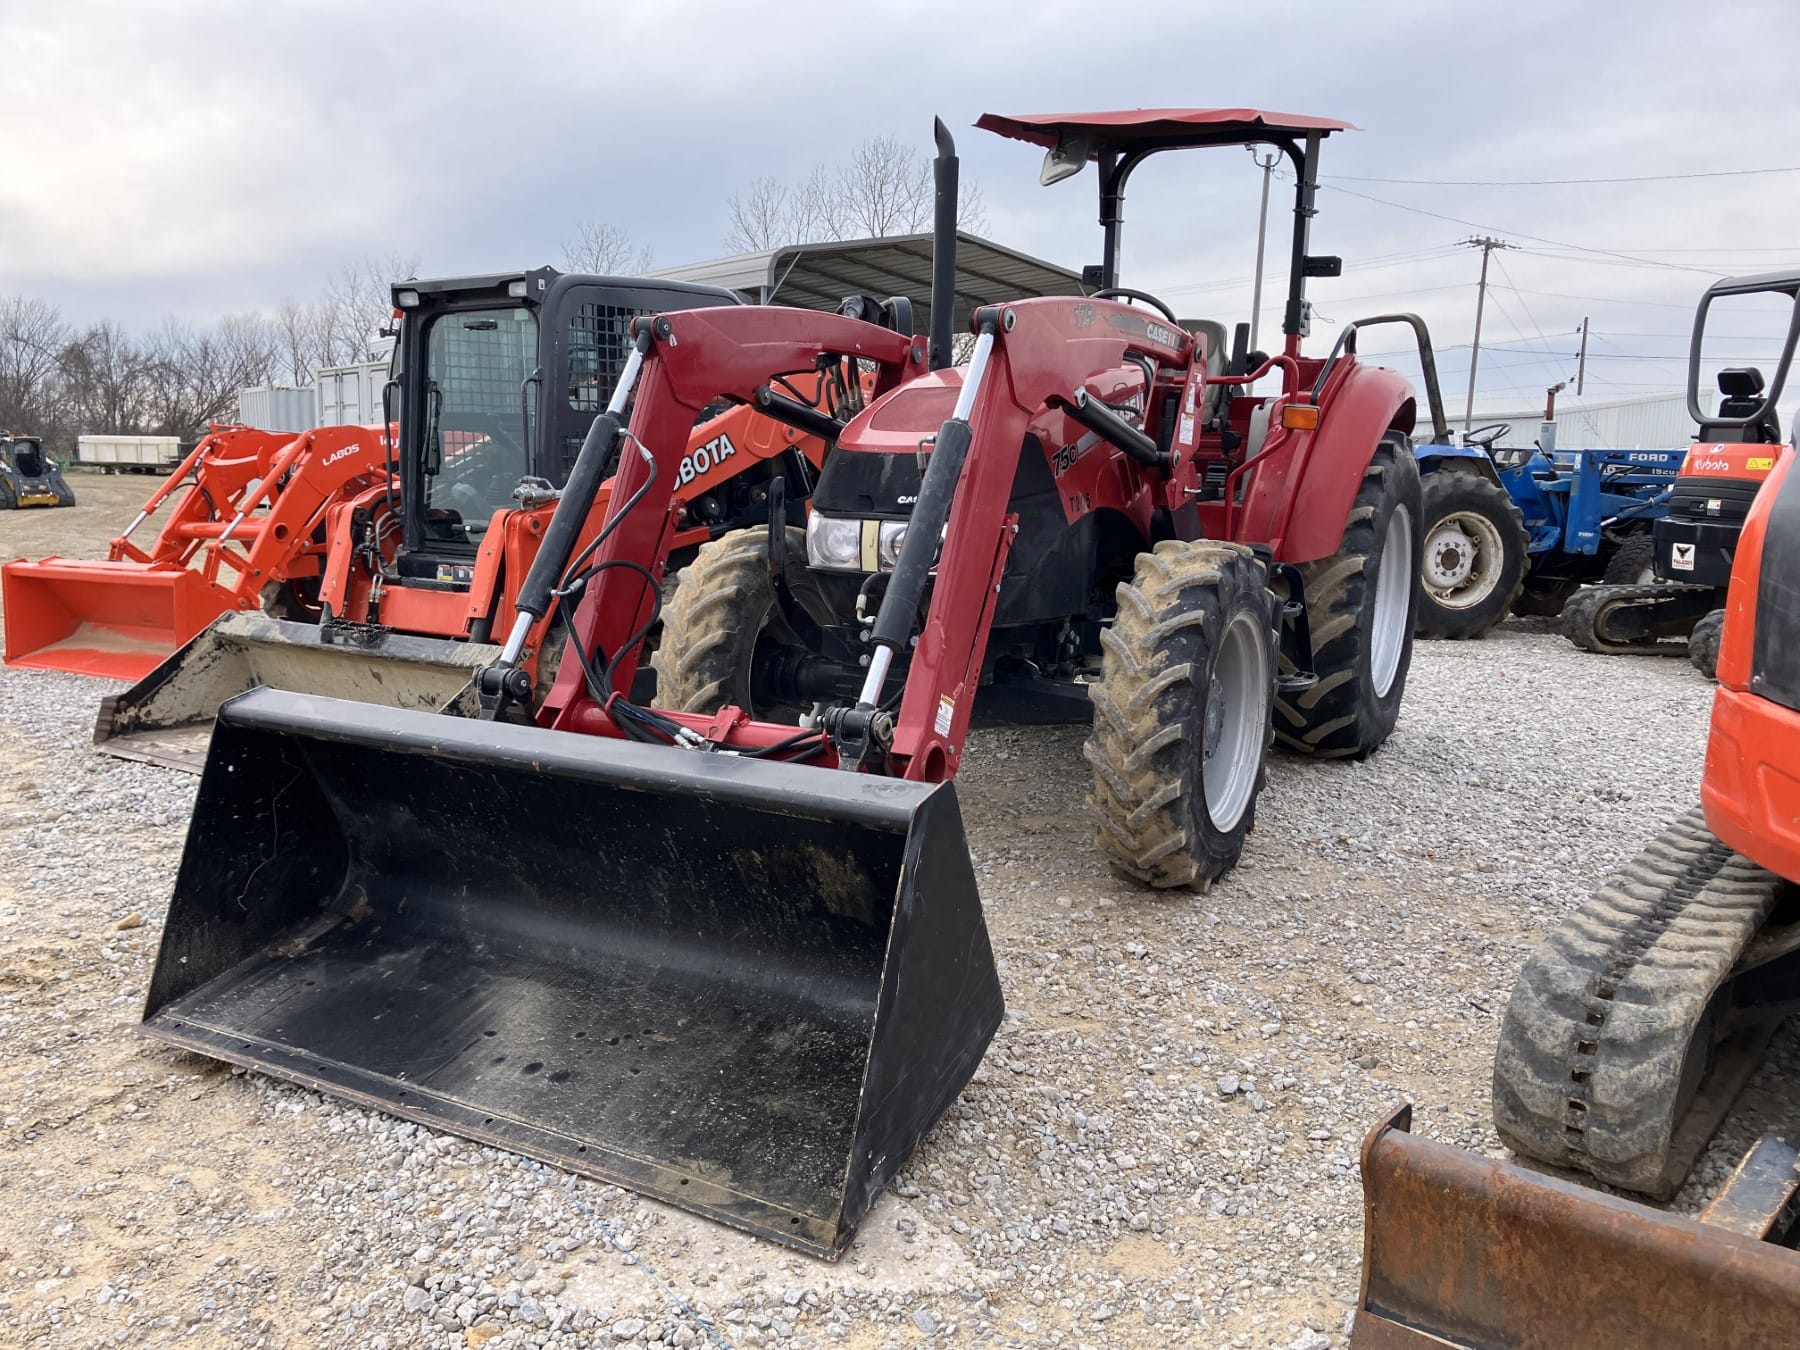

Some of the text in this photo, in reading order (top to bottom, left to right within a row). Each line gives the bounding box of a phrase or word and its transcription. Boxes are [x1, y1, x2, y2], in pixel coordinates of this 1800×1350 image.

[1051, 443, 1079, 479] 75C
[1629, 452, 1668, 462] FORD
[1695, 458, 1729, 471] Kubota
